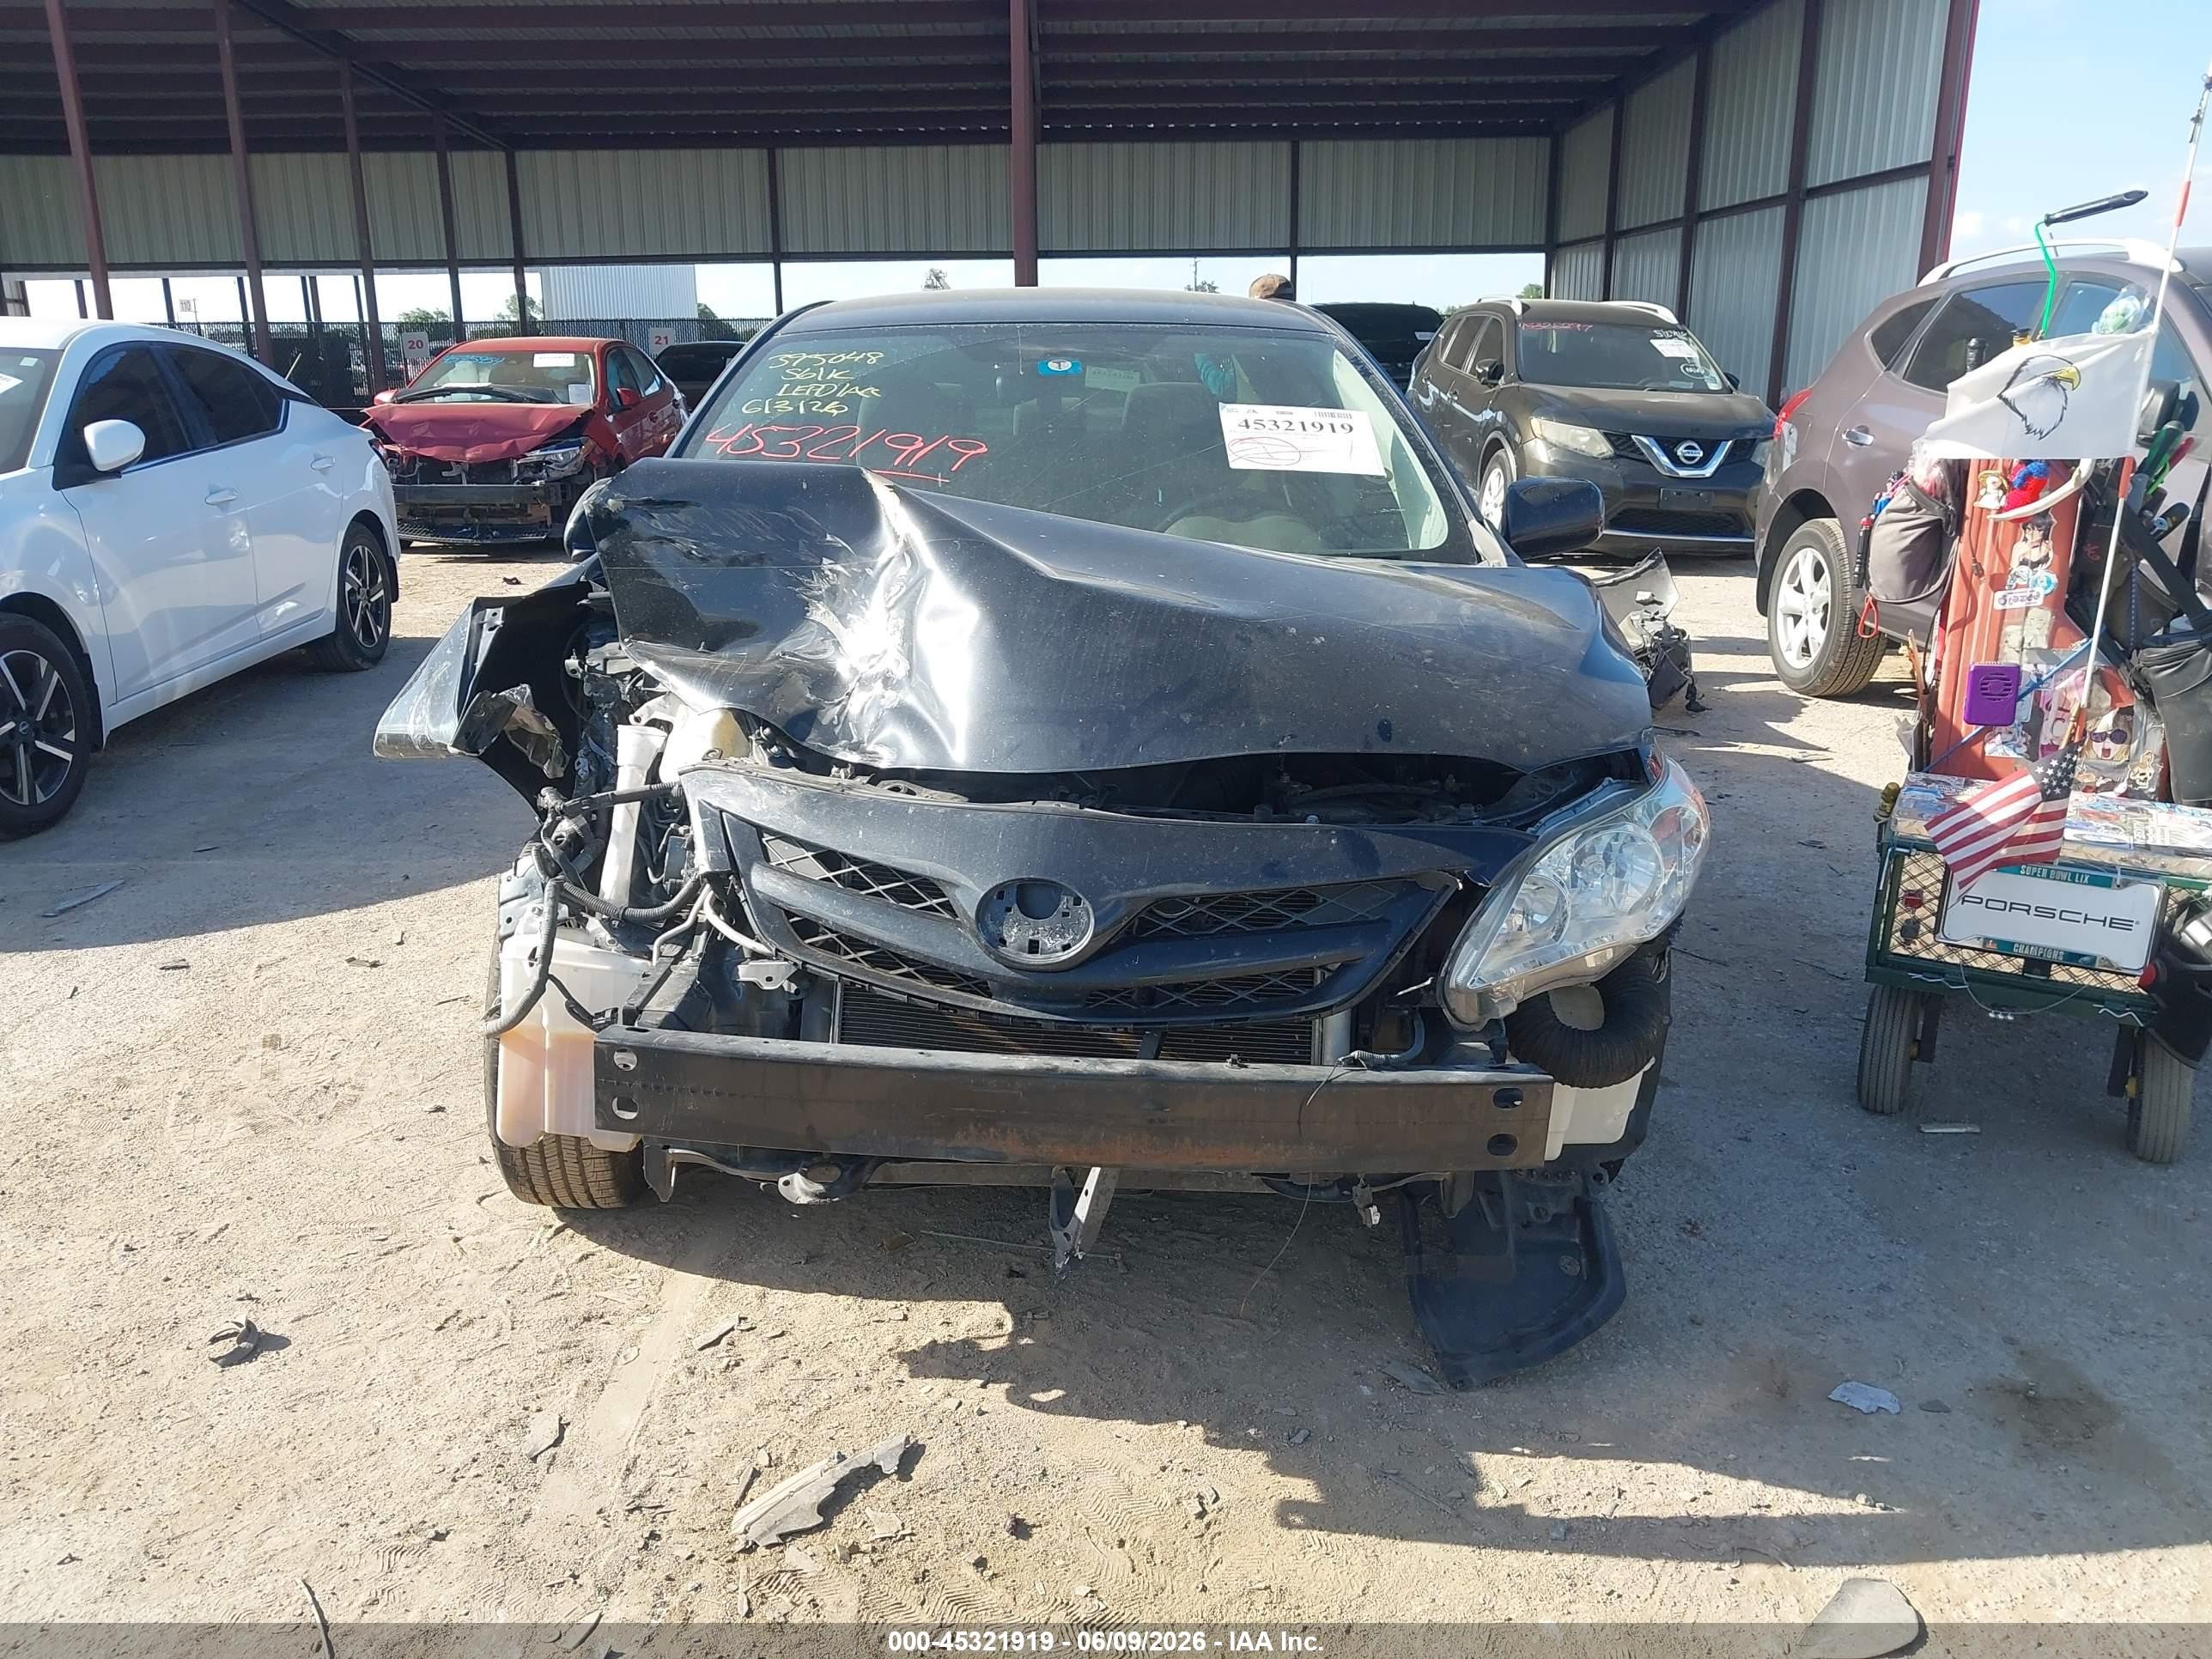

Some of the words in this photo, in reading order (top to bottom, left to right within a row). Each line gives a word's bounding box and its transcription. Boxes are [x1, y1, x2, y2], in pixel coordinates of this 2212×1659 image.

[407, 339, 424, 349] 20
[654, 335, 669, 345] 21
[1237, 418, 1354, 434] 45321919
[705, 422, 988, 472] 45321919
[2020, 866, 2047, 878] SUPER
[2049, 870, 2072, 882] BOWL
[2075, 872, 2089, 884] LIX
[1961, 895, 2135, 931] PORSCHE
[2013, 944, 2064, 960] CHAMPIONS
